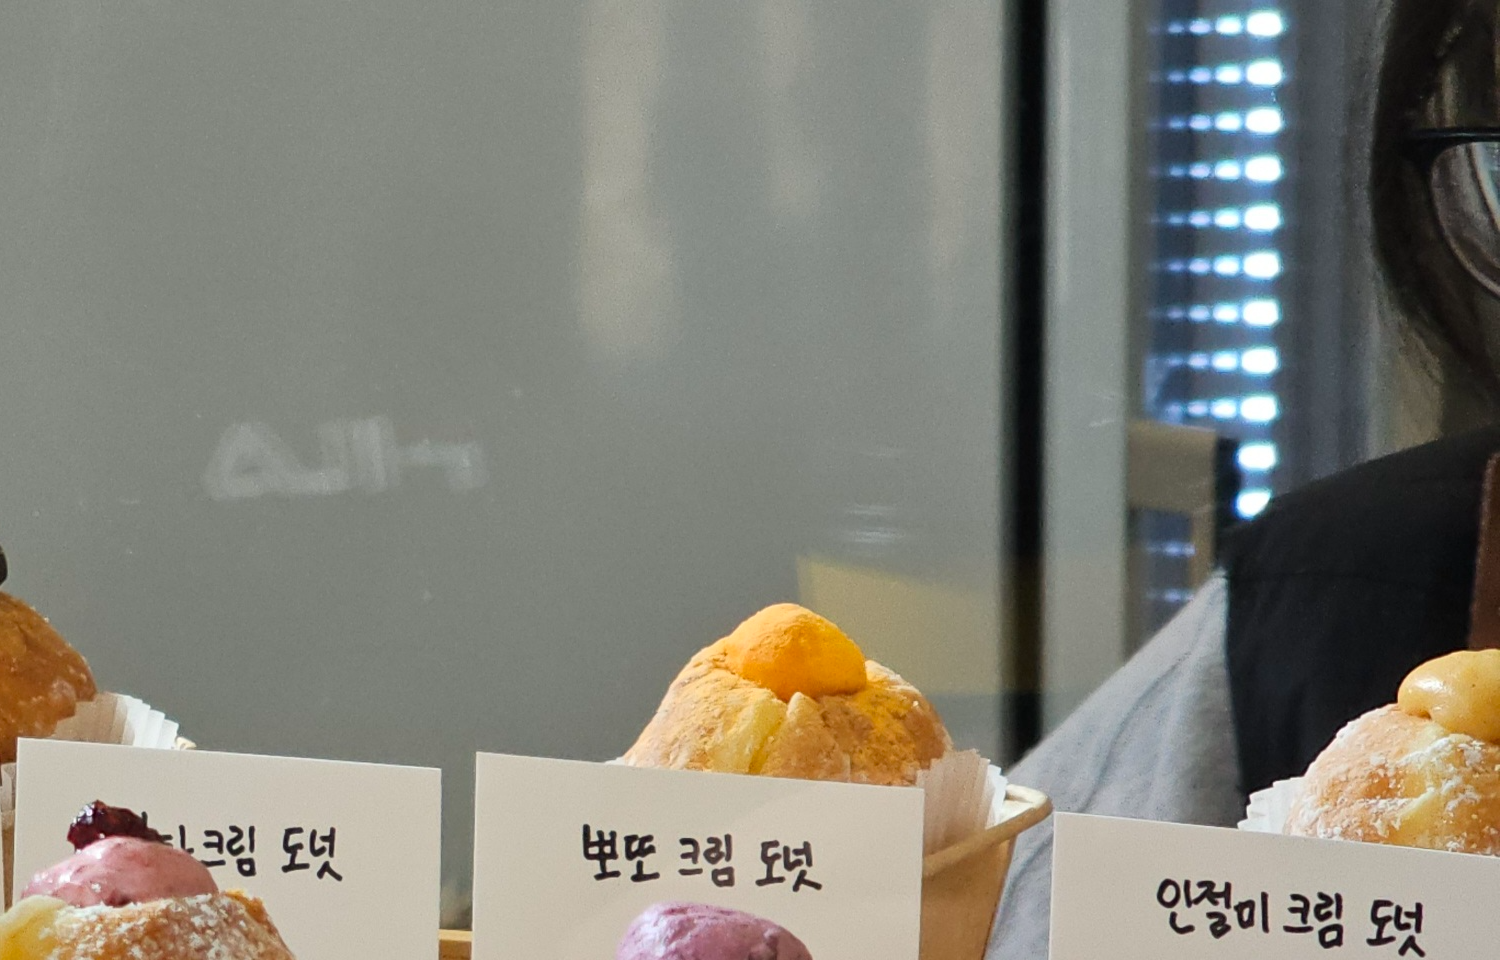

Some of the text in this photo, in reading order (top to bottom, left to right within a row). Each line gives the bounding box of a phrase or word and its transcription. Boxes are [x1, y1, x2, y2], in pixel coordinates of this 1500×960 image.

[281, 826, 343, 882] 도넛
[582, 823, 823, 893] 뽀또 크림 도넛
[1156, 878, 1426, 958] 인절미 크림 도넛
